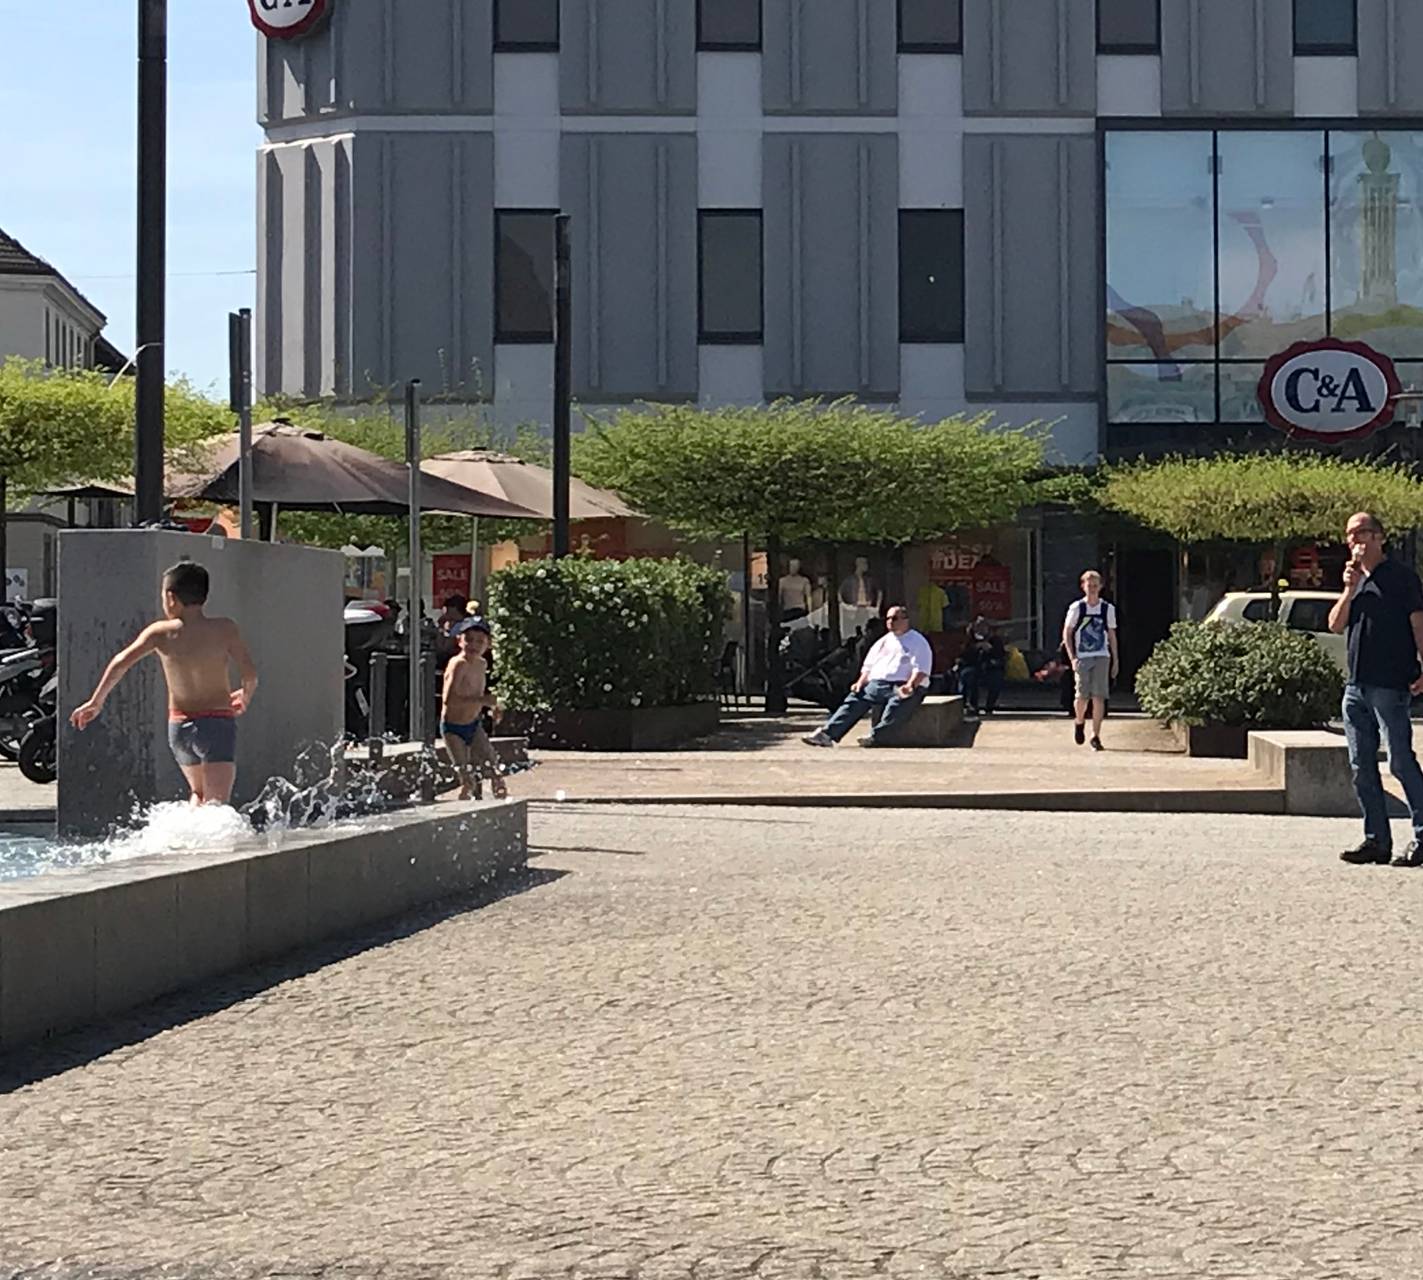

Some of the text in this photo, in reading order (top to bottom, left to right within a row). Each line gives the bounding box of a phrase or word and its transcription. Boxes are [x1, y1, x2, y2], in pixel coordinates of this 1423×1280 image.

[1285, 367, 1376, 413] C&A
[436, 568, 468, 580] SALE
[975, 580, 1007, 593] SALE
